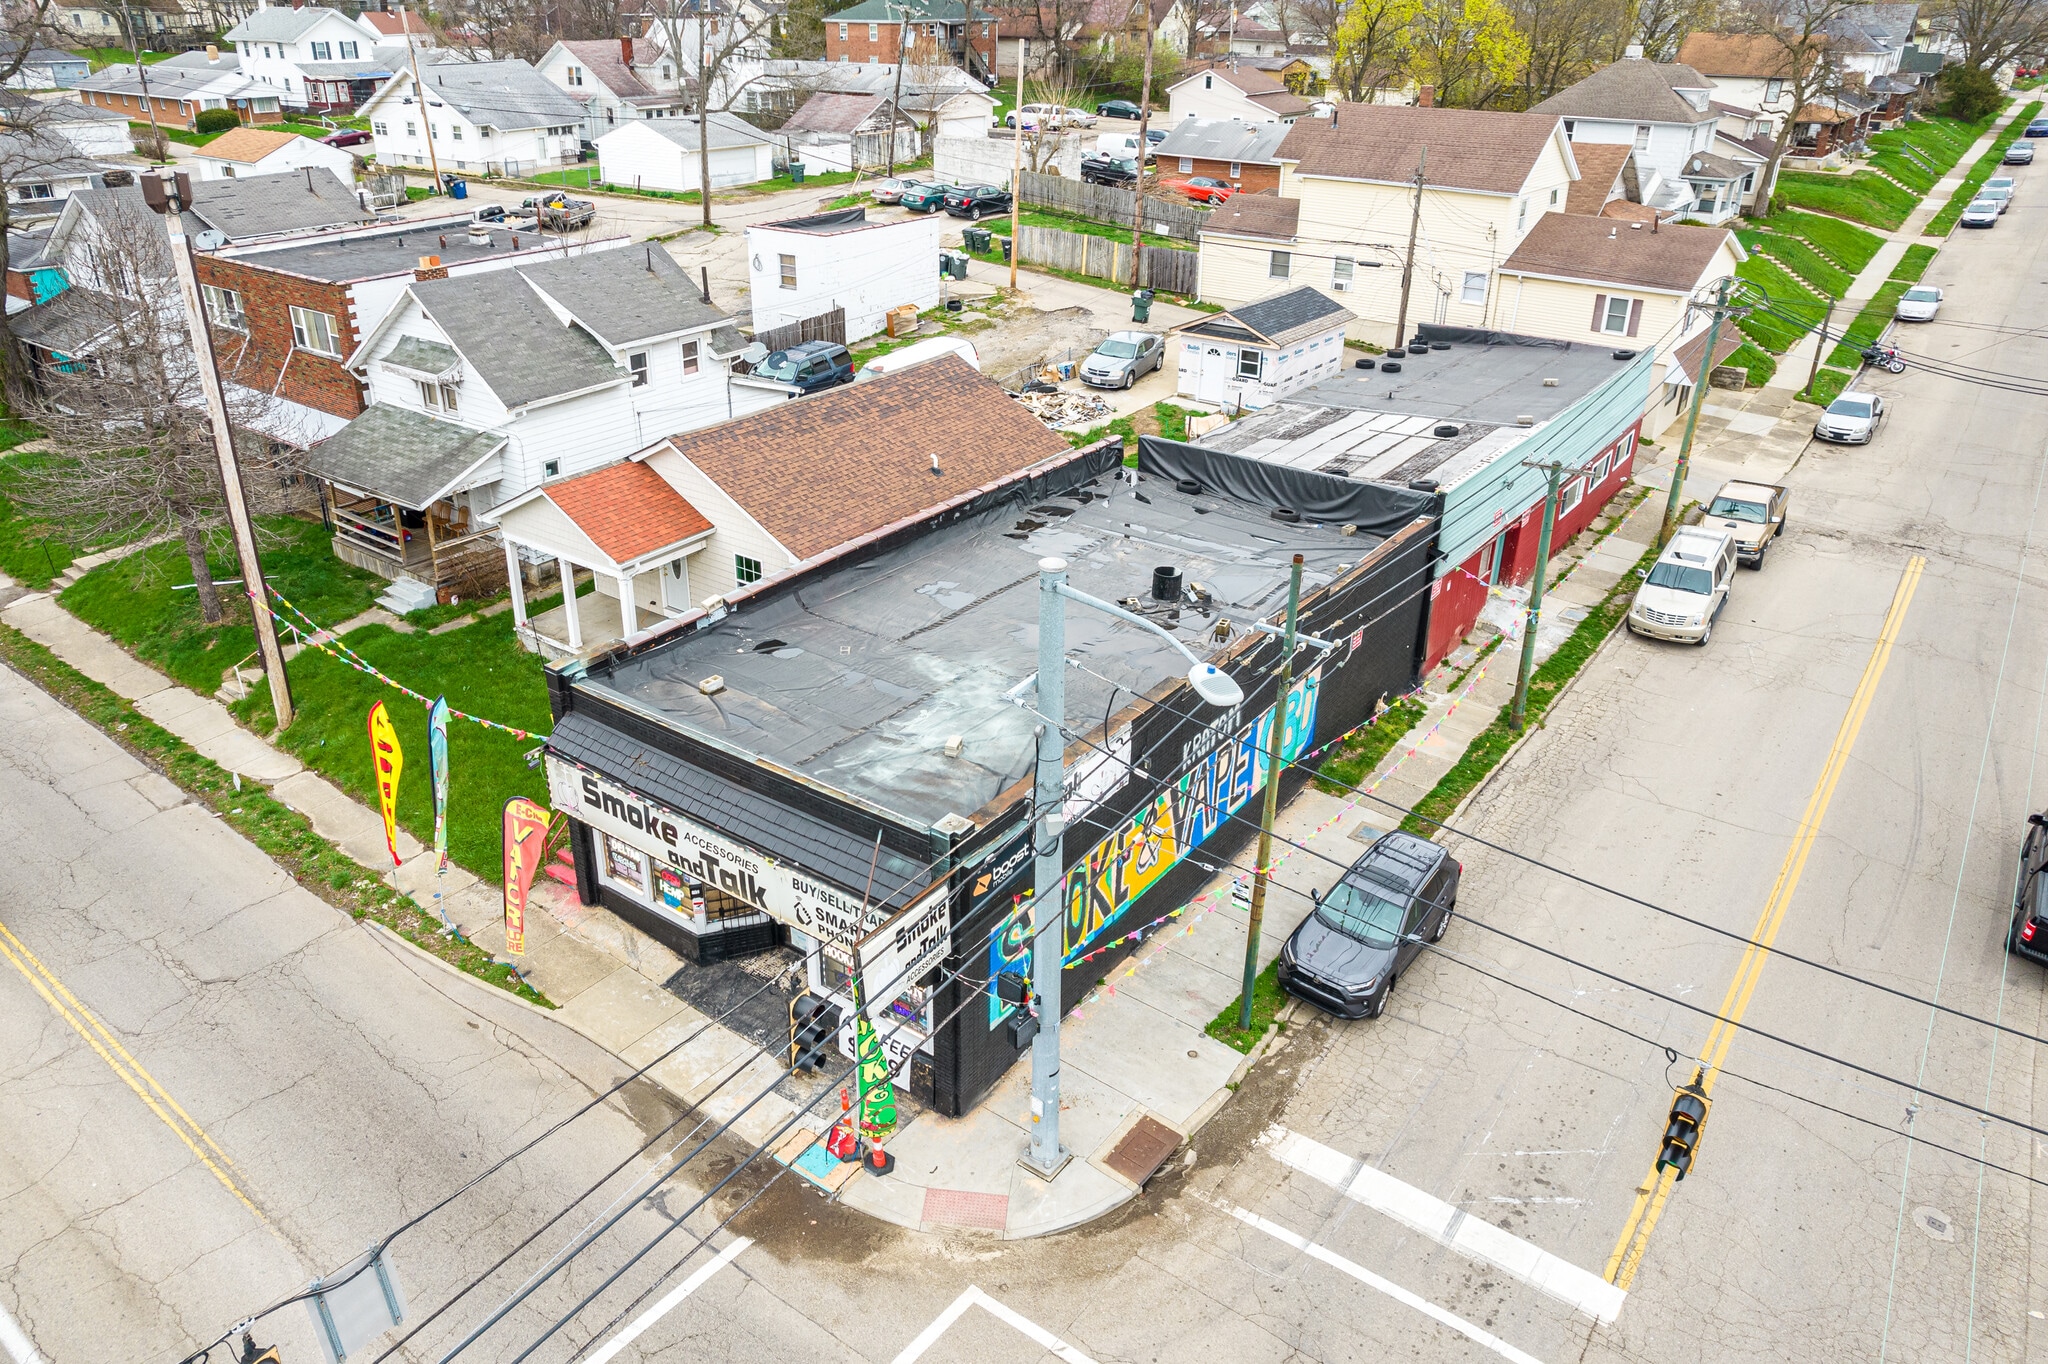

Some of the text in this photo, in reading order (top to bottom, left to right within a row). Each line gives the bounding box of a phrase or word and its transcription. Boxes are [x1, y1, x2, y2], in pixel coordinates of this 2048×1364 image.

[1183, 703, 1241, 772] KRATOM
[582, 775, 759, 875] Smoke ACCESSORIES
[992, 843, 1030, 880] boost
[998, 819, 1134, 1011] SOKE
[1170, 722, 1252, 857] VAPE
[659, 878, 685, 900] HEMP
[792, 877, 885, 928] BUY/SELL/TRAD
[815, 907, 872, 939] SMART
[818, 923, 854, 949] PHON
[896, 902, 948, 954] Smoke
[906, 946, 945, 984] ACCESSORIES
